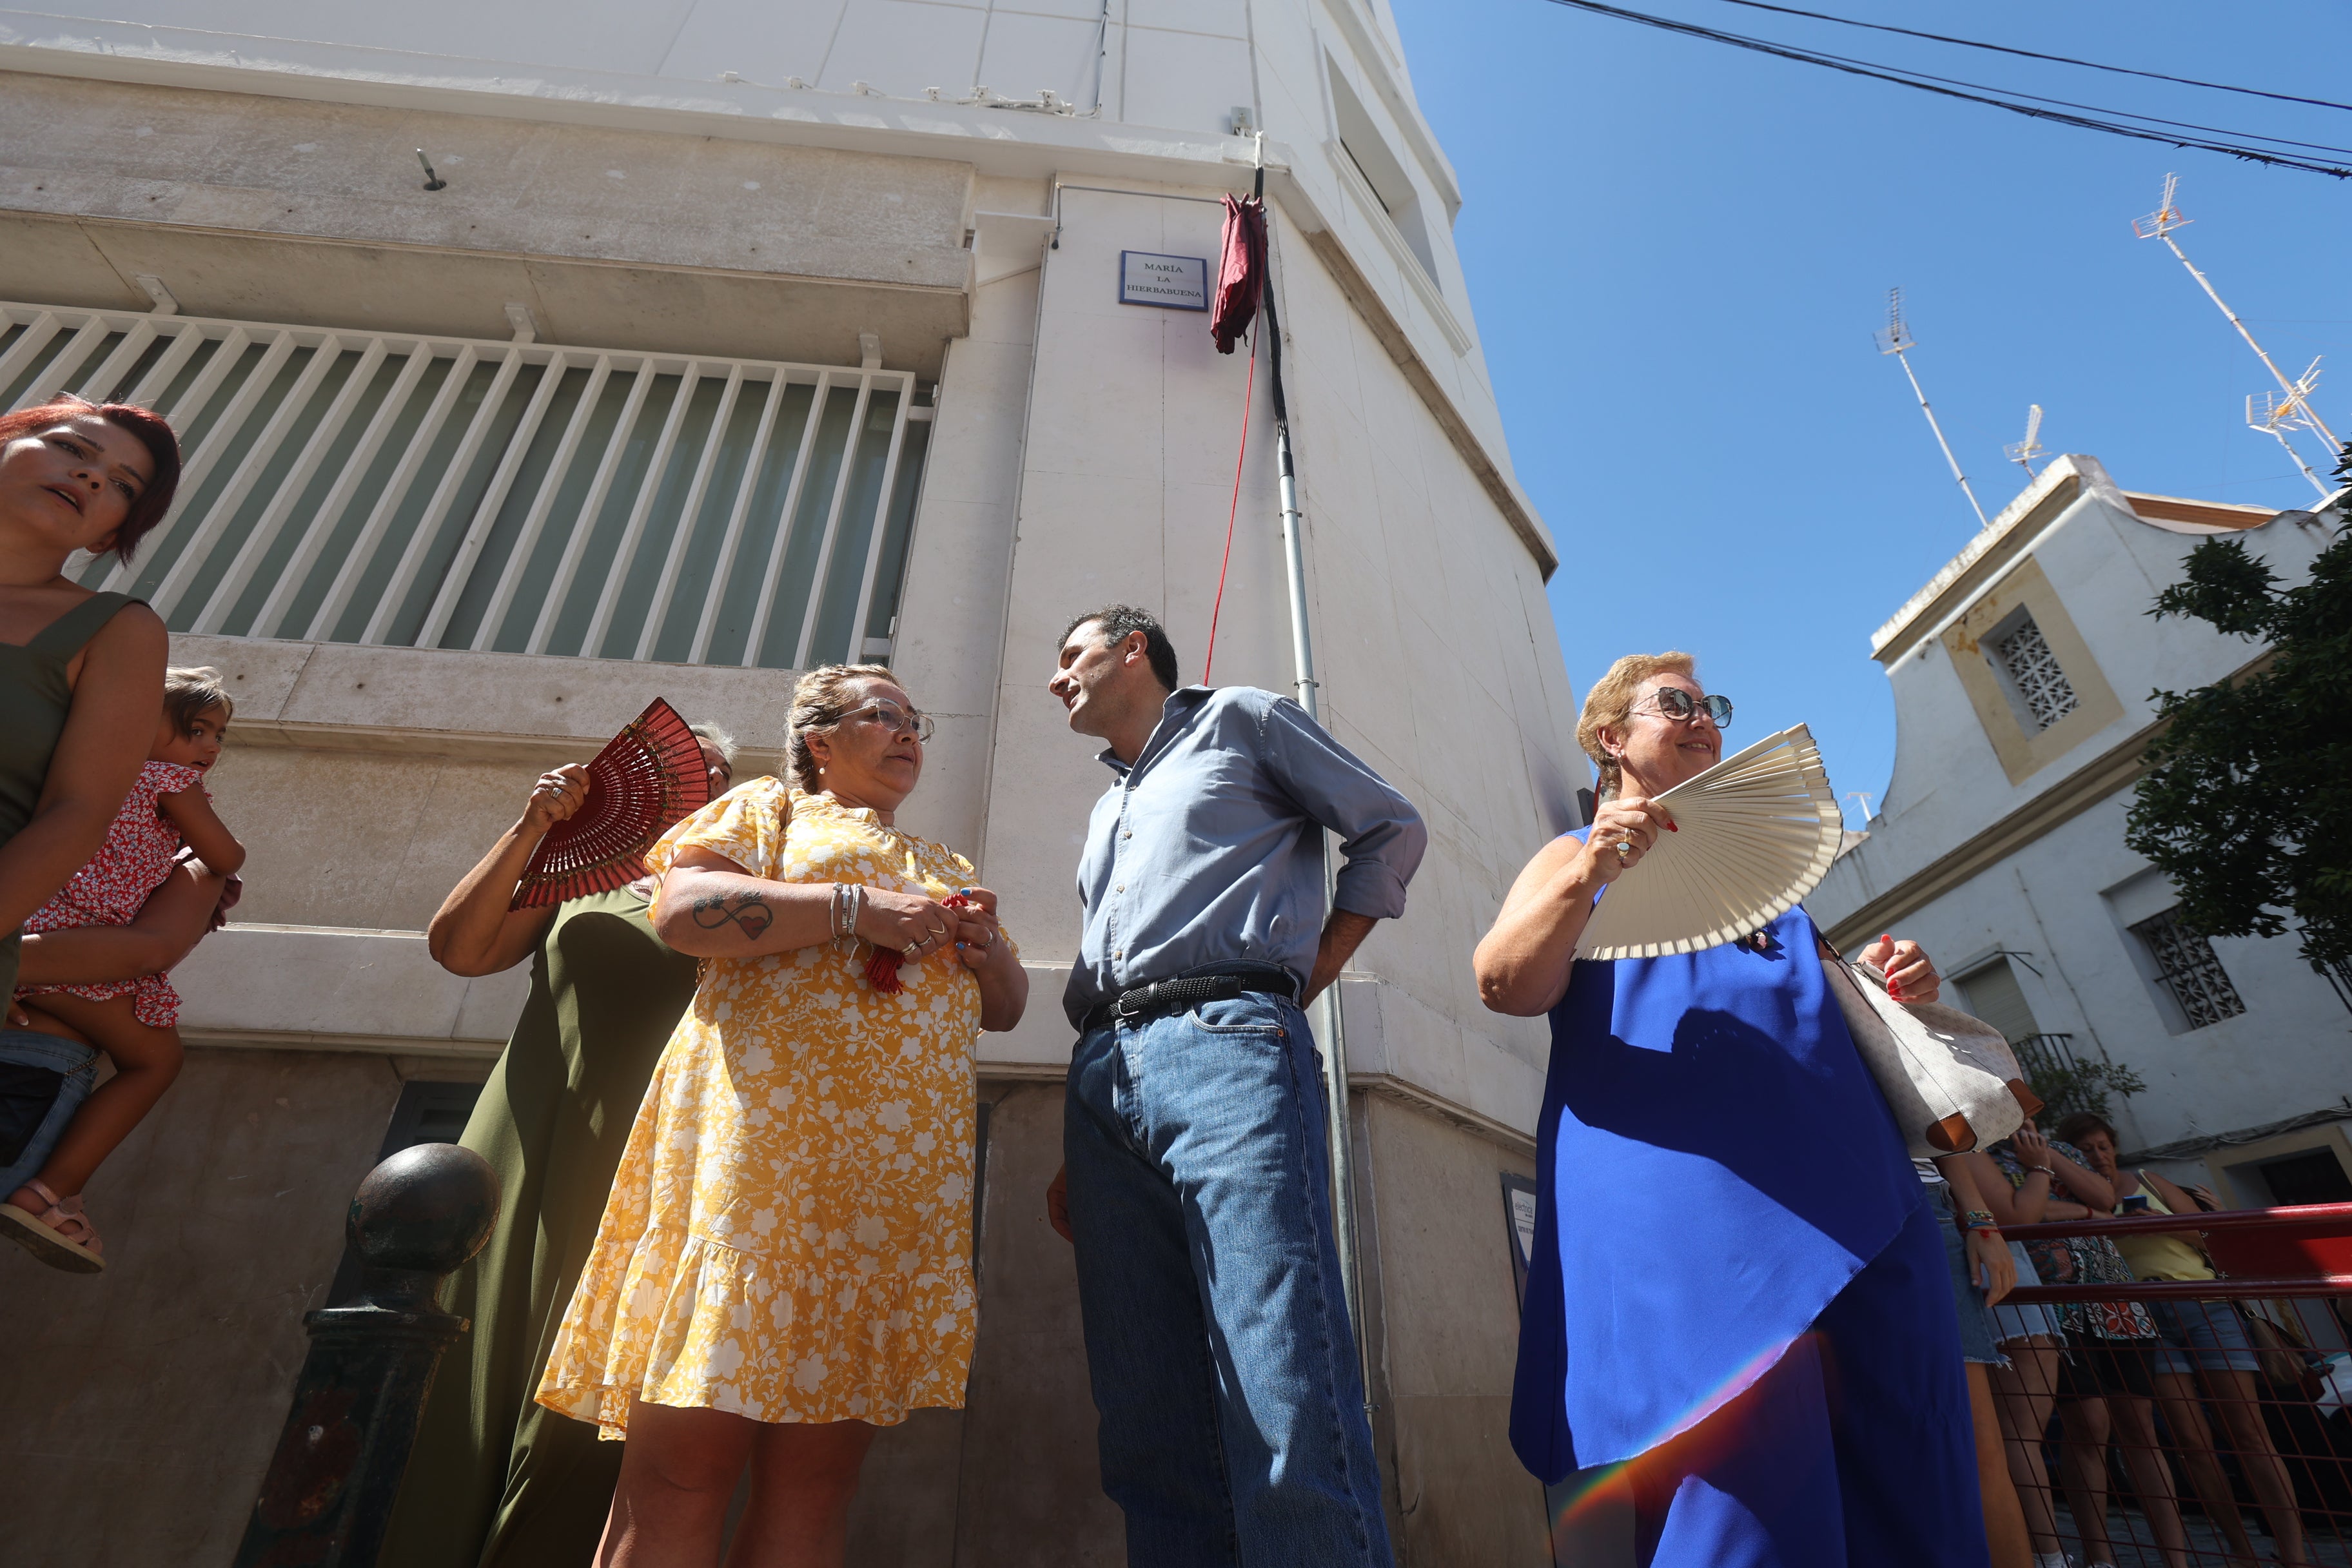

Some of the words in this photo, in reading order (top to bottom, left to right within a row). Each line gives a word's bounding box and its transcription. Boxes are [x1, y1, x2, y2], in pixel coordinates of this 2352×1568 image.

[1144, 263, 1183, 273] MARÍA
[1127, 285, 1201, 297] HIERBABUENA
[1515, 1202, 1533, 1214] eléctrica
